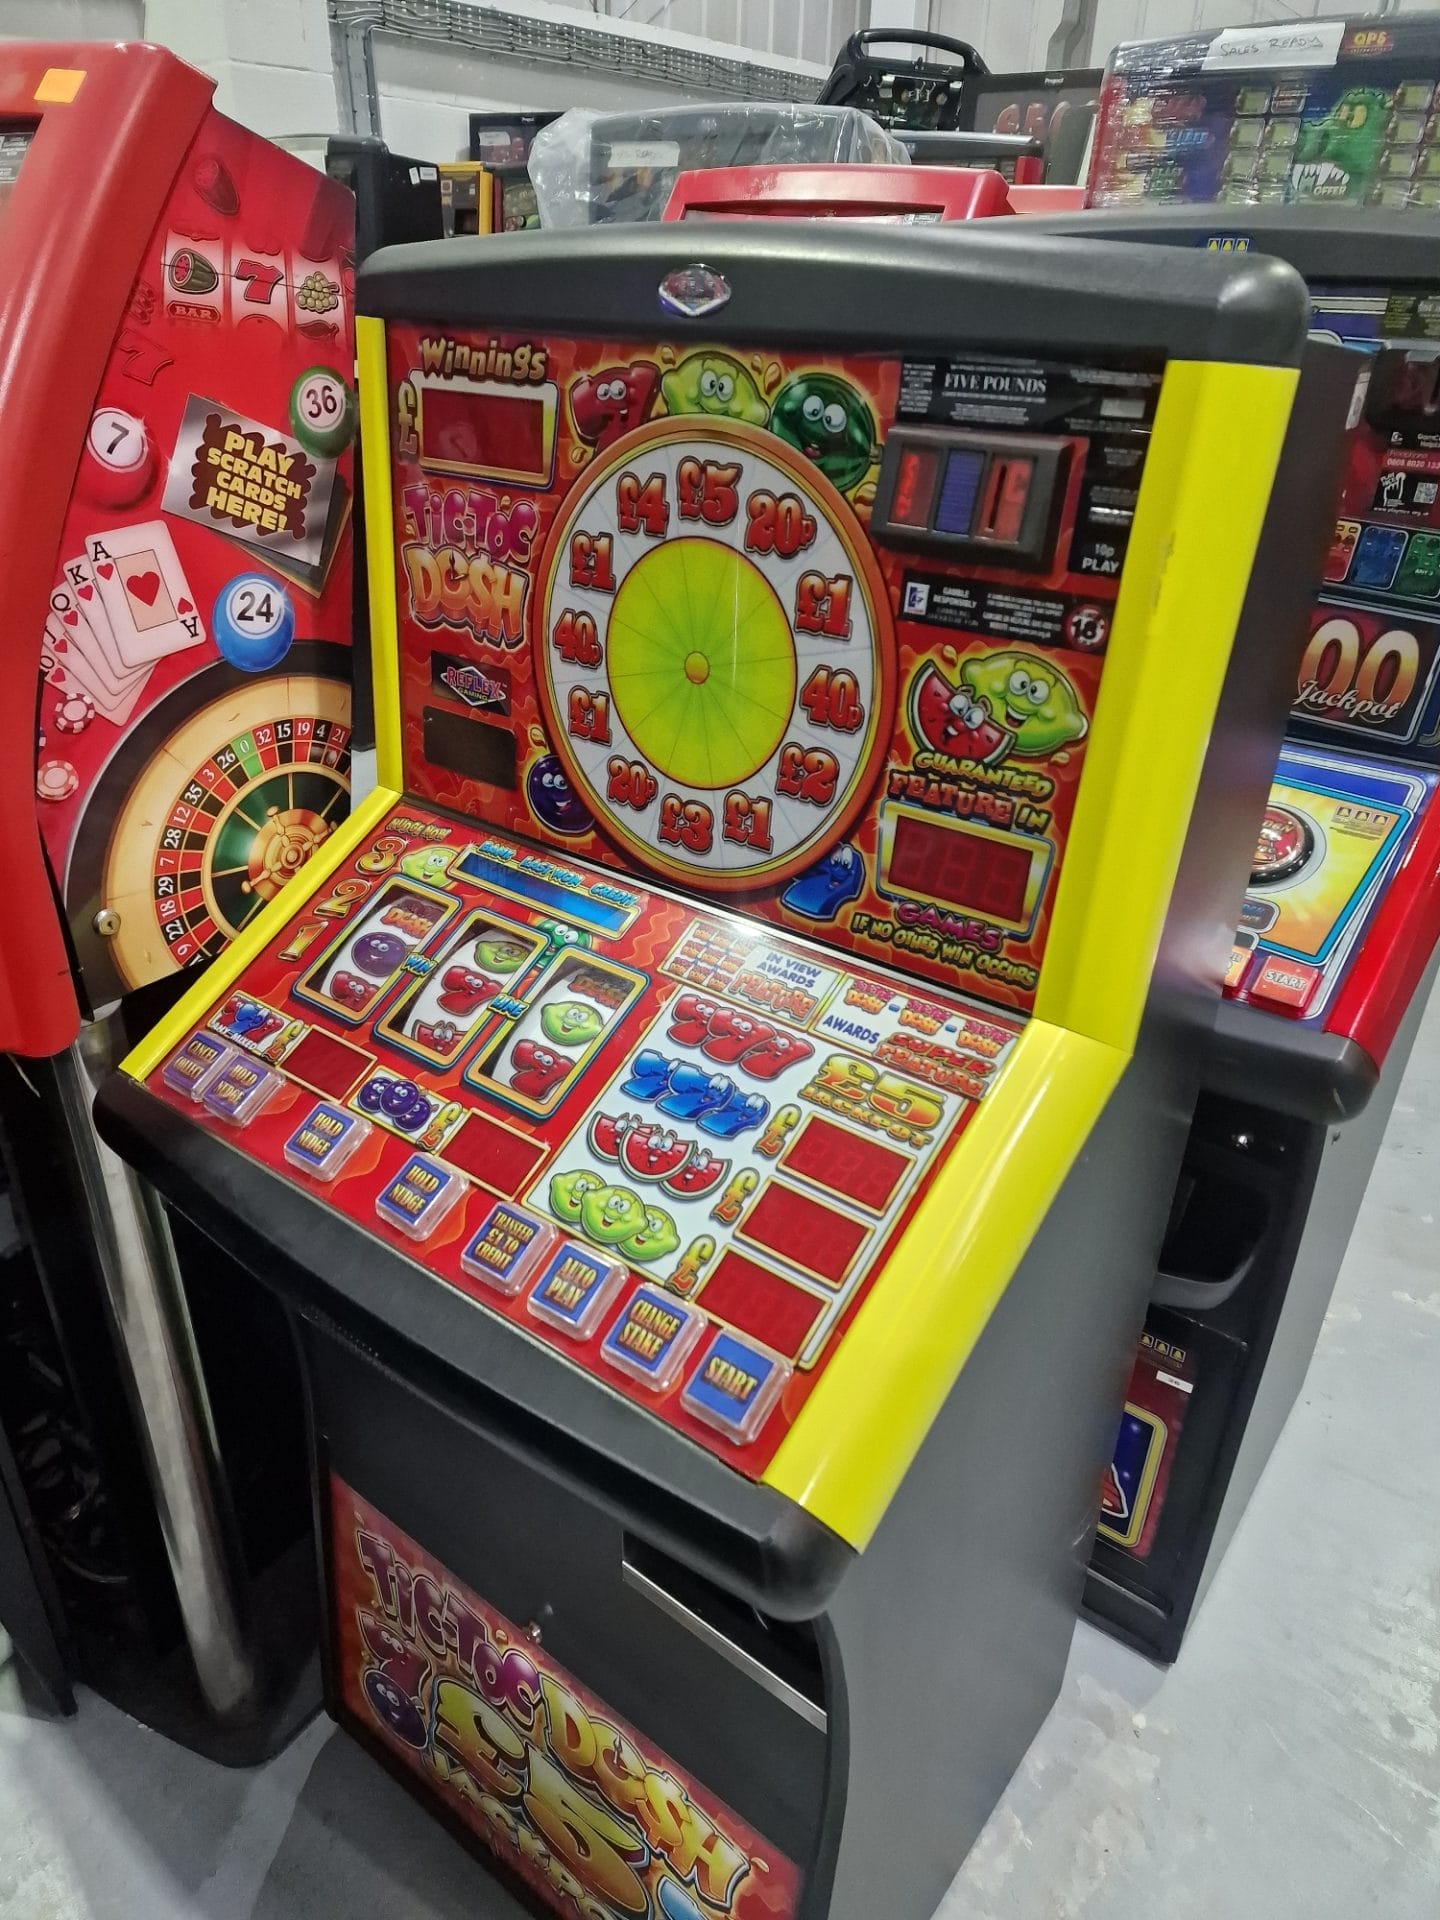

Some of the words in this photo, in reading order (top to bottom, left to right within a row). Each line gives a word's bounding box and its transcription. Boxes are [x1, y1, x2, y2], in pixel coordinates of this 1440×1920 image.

[175, 305, 214, 319] BAR
[421, 337, 548, 380] Winnings
[944, 373, 981, 390] FIVE
[983, 375, 1047, 393] POUNDS
[306, 385, 337, 419] 36
[398, 381, 417, 455] £
[106, 422, 129, 455] 7
[224, 430, 295, 476] PLAY
[207, 447, 302, 500] SCRATCH
[216, 470, 287, 511] CARDS
[617, 472, 670, 538] £4
[676, 456, 743, 527] £5
[206, 486, 288, 533] HERE!
[744, 489, 817, 559] 20p
[92, 541, 112, 562] A
[570, 530, 616, 594] £1
[1082, 557, 1120, 573] PLAY
[68, 564, 89, 586] K
[52, 593, 71, 612] Q
[237, 591, 274, 623] 24
[794, 570, 853, 641] £1
[552, 607, 603, 669] 40p
[1072, 618, 1097, 640] 18
[446, 666, 502, 700] REFLEX
[457, 686, 488, 702] GAMING
[800, 664, 865, 734] 40p
[568, 685, 613, 747] £1
[1292, 680, 1402, 723] Jackpot
[256, 727, 272, 745] 32
[277, 723, 291, 738] 15
[297, 722, 310, 737] 19
[316, 724, 326, 738] 4
[331, 728, 346, 743] 21
[217, 751, 236, 770] 26
[240, 739, 250, 754] 0
[202, 768, 215, 783] 3
[606, 754, 659, 811] 20p
[774, 742, 840, 806] £2
[914, 752, 1053, 800] GUARANTEED
[184, 784, 203, 806] 35
[889, 772, 1015, 826] FEATURE
[1016, 806, 1050, 834] IN
[173, 805, 191, 825] 12
[386, 817, 425, 838] NUDGE
[421, 825, 452, 842] NOW
[657, 793, 715, 854] £3
[722, 789, 774, 854] £1
[164, 828, 182, 848] 28
[478, 841, 515, 863] BANK
[160, 856, 175, 867] 7
[355, 836, 408, 876] 3
[519, 856, 552, 877] LAST
[550, 866, 584, 887] WON
[158, 876, 174, 896] 29
[313, 878, 372, 918] 2
[588, 881, 639, 907] CREDIT
[160, 899, 176, 917] 18
[166, 921, 185, 941] 22
[278, 920, 328, 963] 1
[896, 903, 1002, 951] GAMES
[401, 952, 437, 976] WIN
[765, 951, 784, 965] IN
[785, 958, 822, 978] VIEW
[852, 914, 869, 934] IF
[870, 920, 893, 940] NO
[894, 930, 939, 957] OTHER
[942, 941, 973, 968] WIN
[975, 955, 1037, 989] OCCURS
[756, 961, 817, 989] AWARDS
[1265, 970, 1306, 990] START
[729, 970, 819, 1021] FEATURE
[261, 1019, 305, 1062] £
[823, 1014, 880, 1045] AWARDS
[873, 1044, 990, 1098] FEATURE
[888, 1032, 997, 1077] SUPER
[229, 1063, 258, 1087] HOLD
[213, 1080, 245, 1105] NUDGE
[811, 1053, 949, 1131] £5
[312, 1111, 345, 1138] HOLD
[414, 1101, 463, 1151] £
[753, 1103, 803, 1160] £
[798, 1083, 934, 1150] JACKPOT
[296, 1128, 332, 1157] NUDGE
[405, 1164, 440, 1193] HOLD
[388, 1183, 426, 1215] NUDGE
[710, 1167, 760, 1224] £
[485, 1227, 504, 1247] £1
[504, 1234, 520, 1254] TO
[492, 1210, 534, 1243] TRANSFER
[474, 1241, 514, 1270] CREDIT
[665, 1234, 717, 1294] £
[559, 1256, 598, 1290] AUTO
[544, 1275, 586, 1311] PLAY
[630, 1299, 681, 1341] CHANGE
[618, 1321, 664, 1361] STAKE
[703, 1356, 758, 1401] START
